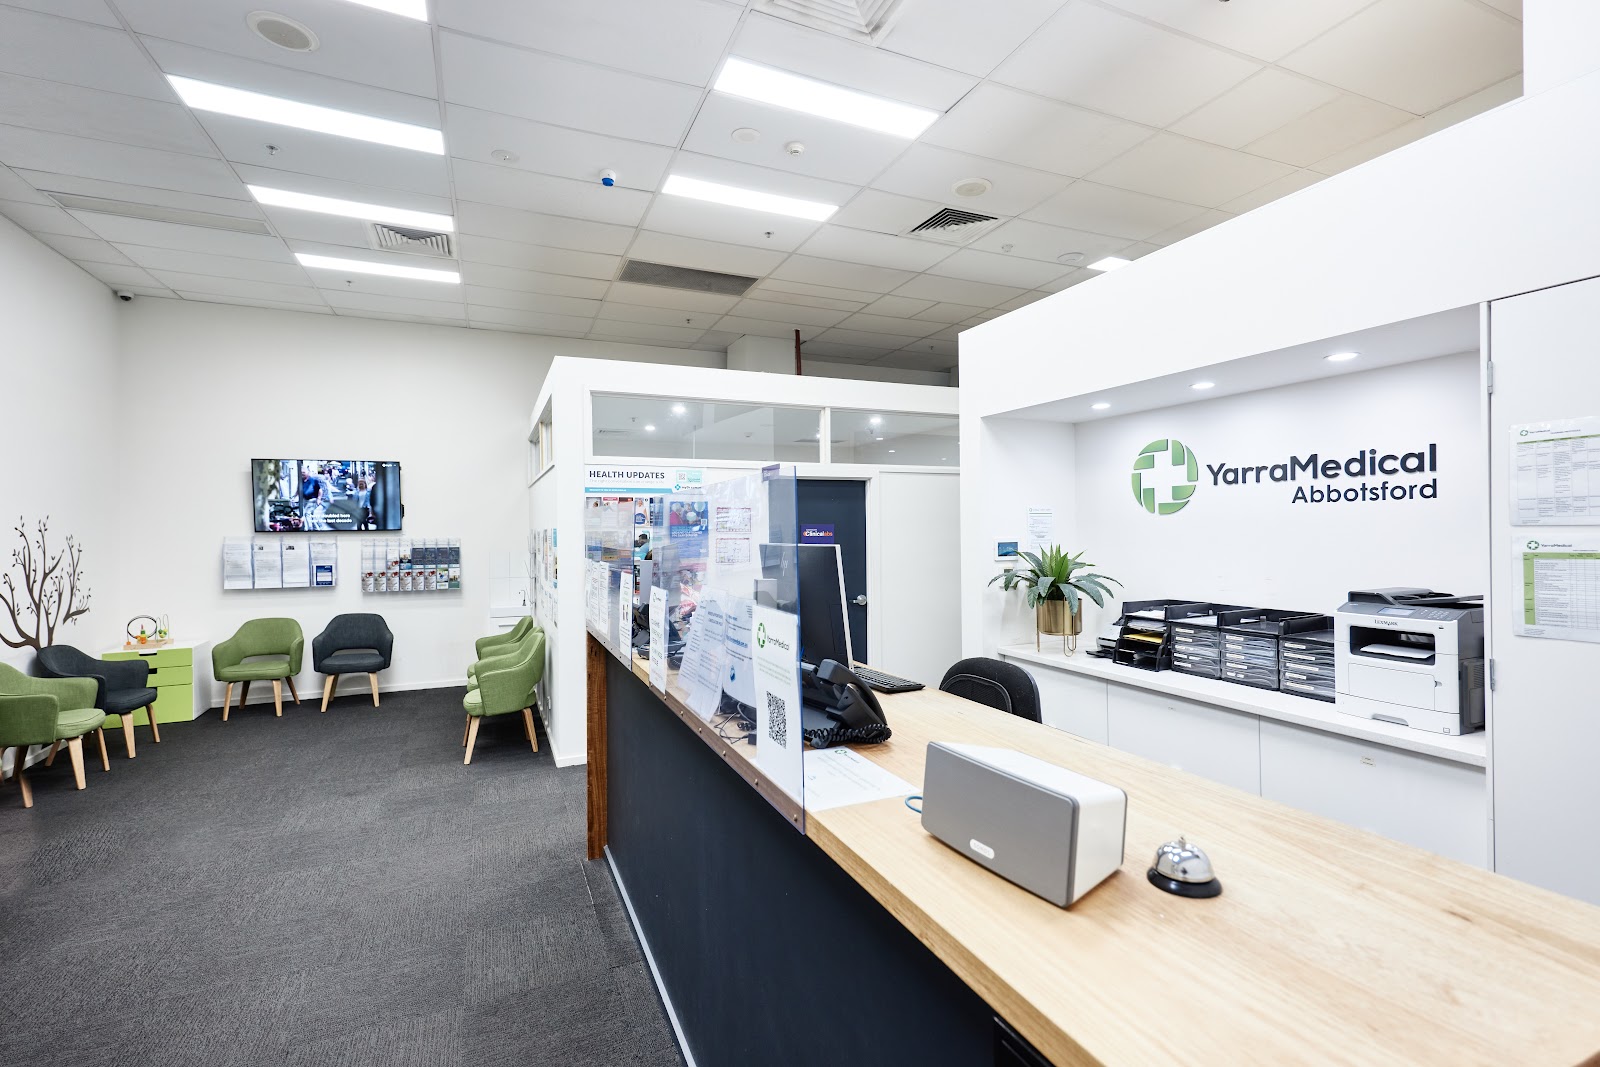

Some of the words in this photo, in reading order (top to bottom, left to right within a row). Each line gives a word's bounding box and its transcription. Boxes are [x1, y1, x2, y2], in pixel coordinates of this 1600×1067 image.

[589, 470, 624, 478] HEALTH
[626, 471, 665, 479] UPDATES
[1206, 443, 1437, 486] YarraMedical
[1291, 478, 1438, 504] Abbotsford
[767, 635, 790, 651] YarraMedical
